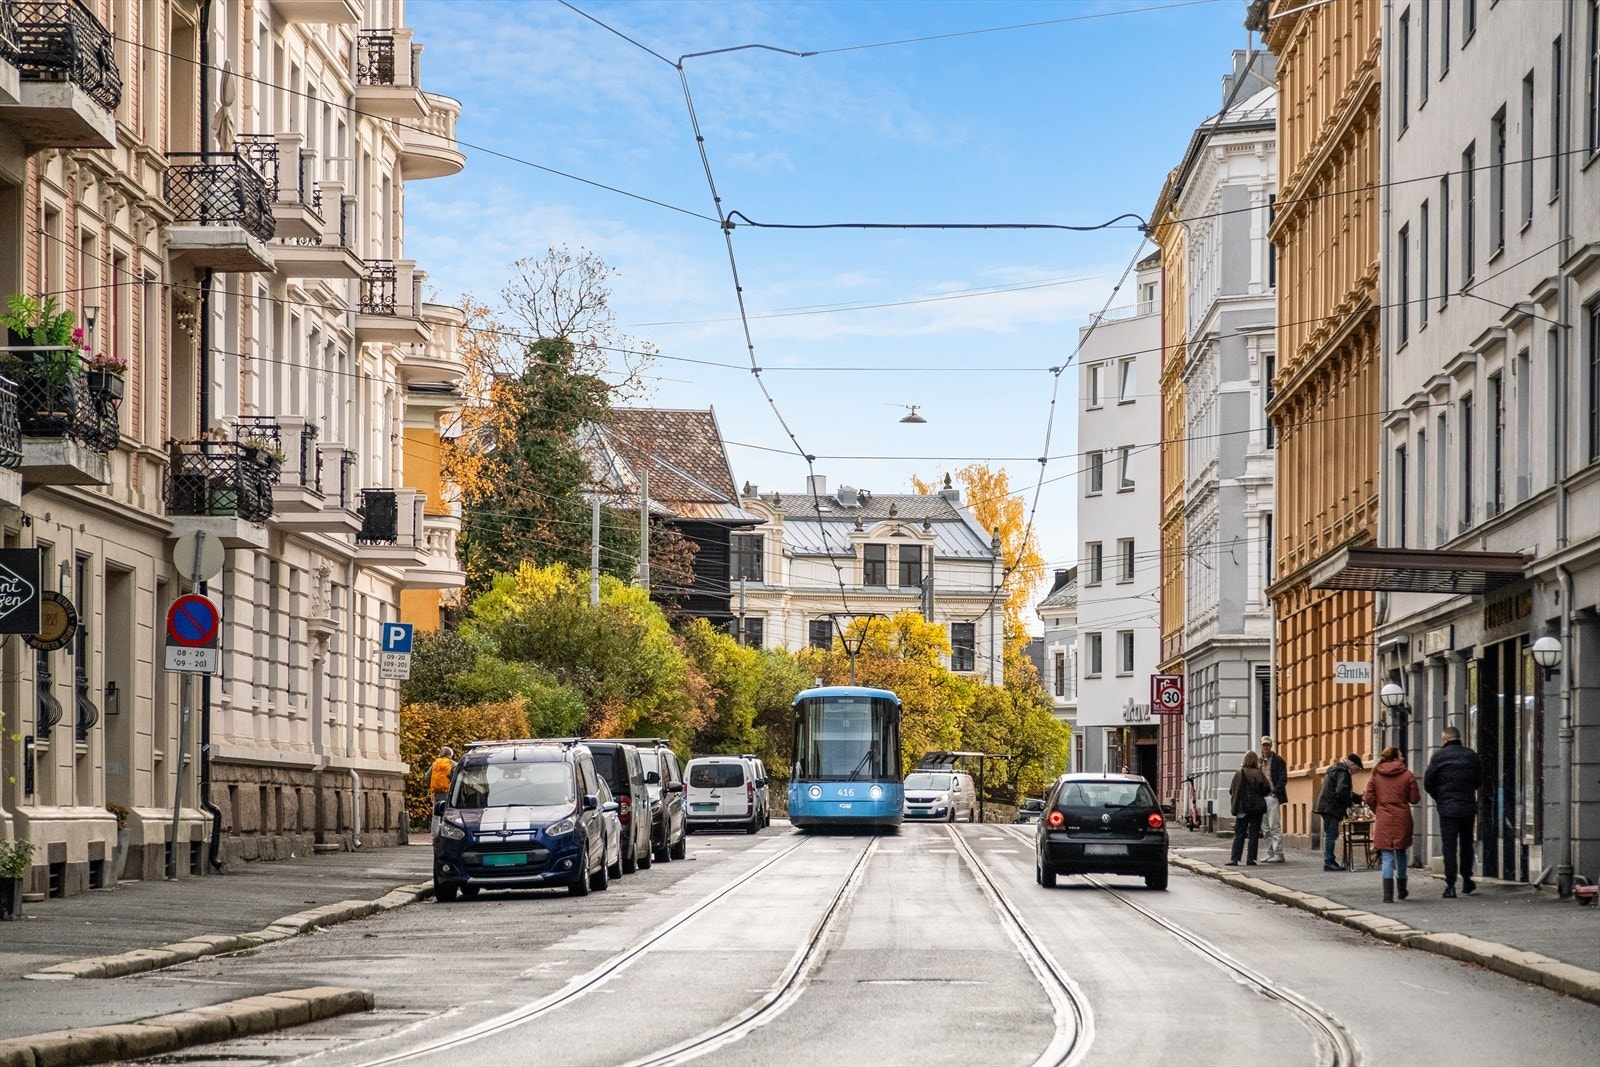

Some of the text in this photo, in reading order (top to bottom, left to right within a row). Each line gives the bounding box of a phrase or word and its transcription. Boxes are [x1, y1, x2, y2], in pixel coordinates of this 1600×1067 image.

[389, 626, 406, 649] P
[177, 649, 187, 657] 08
[195, 660, 207, 668] 20)
[1337, 664, 1370, 679] Antikk
[1164, 691, 1180, 704] 30
[837, 788, 855, 797] 416
